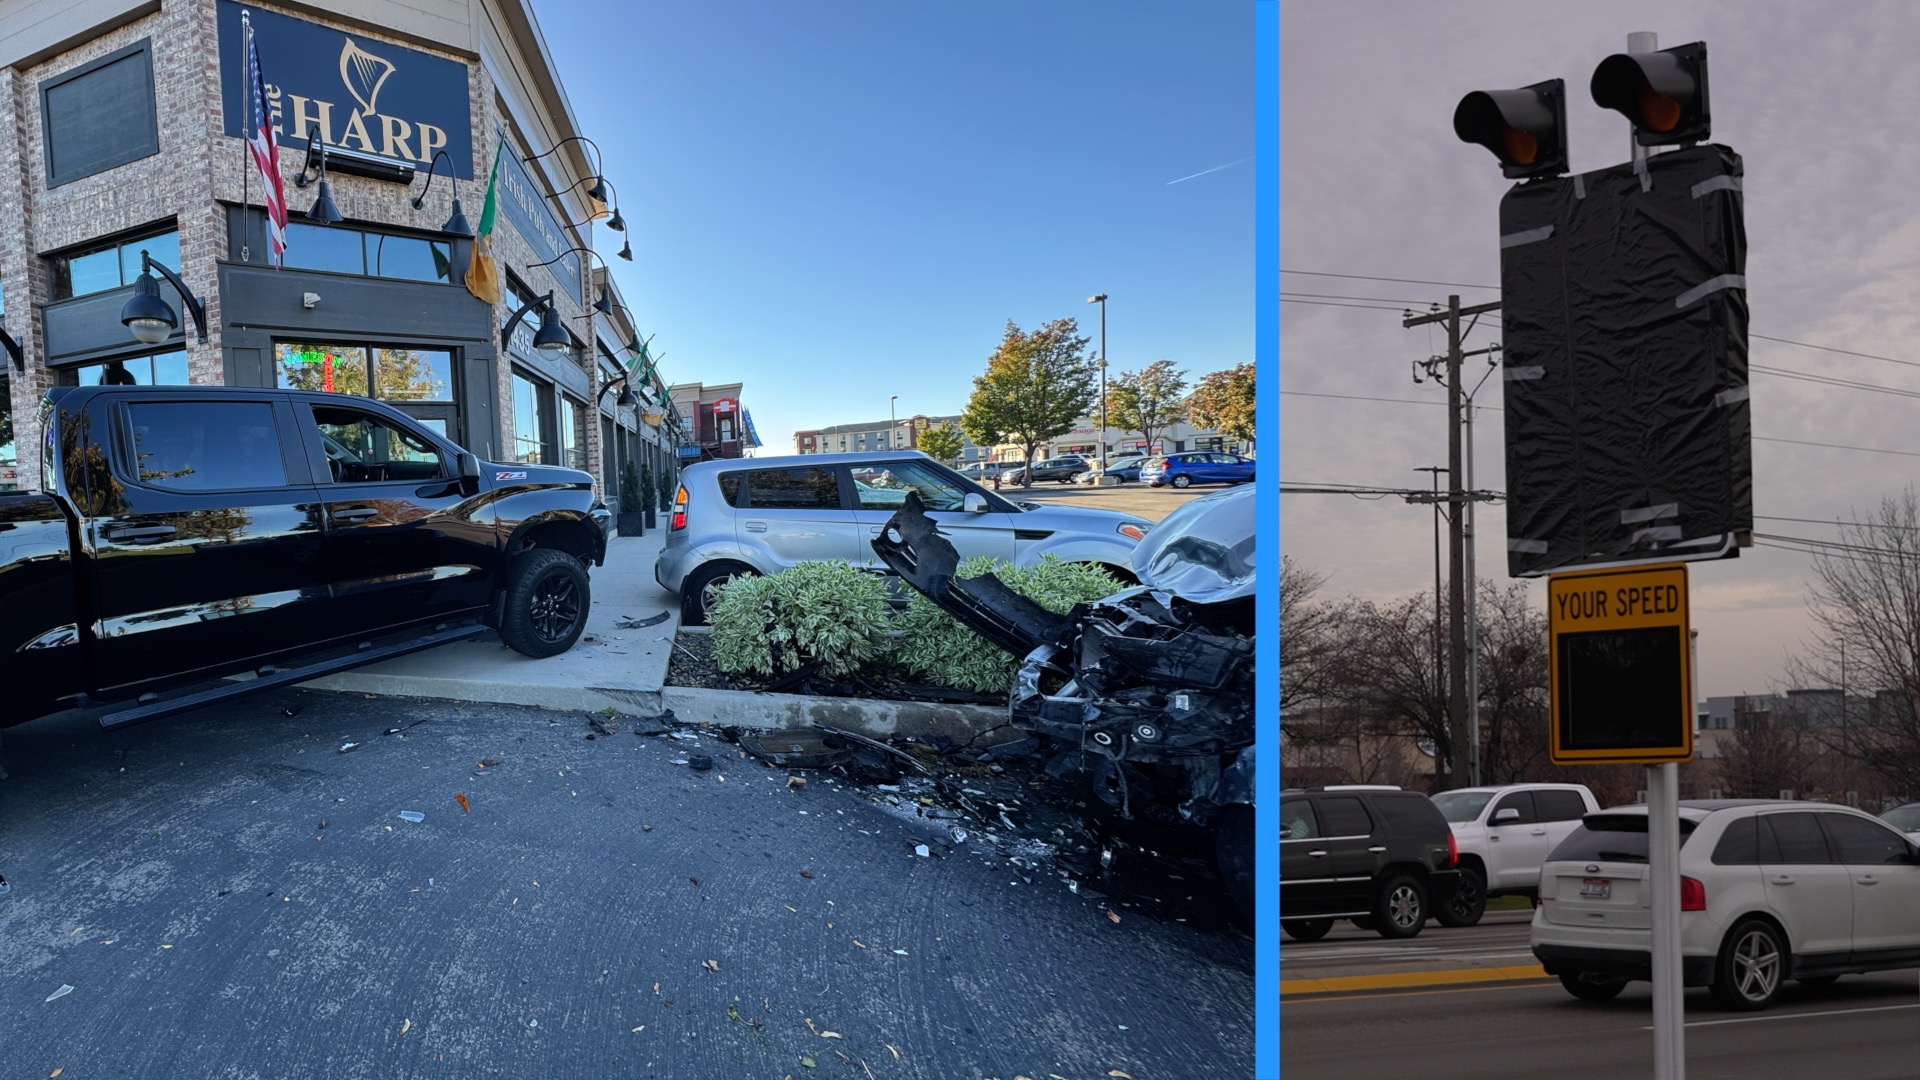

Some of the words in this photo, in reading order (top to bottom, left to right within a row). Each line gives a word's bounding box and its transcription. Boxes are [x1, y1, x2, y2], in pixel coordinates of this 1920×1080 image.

[287, 93, 447, 164] HARP
[503, 160, 527, 214] Irish
[528, 196, 544, 237] Pub
[284, 351, 343, 368] JAMESON
[1556, 590, 1608, 620] YOUR
[1616, 584, 1679, 616] SPEED
